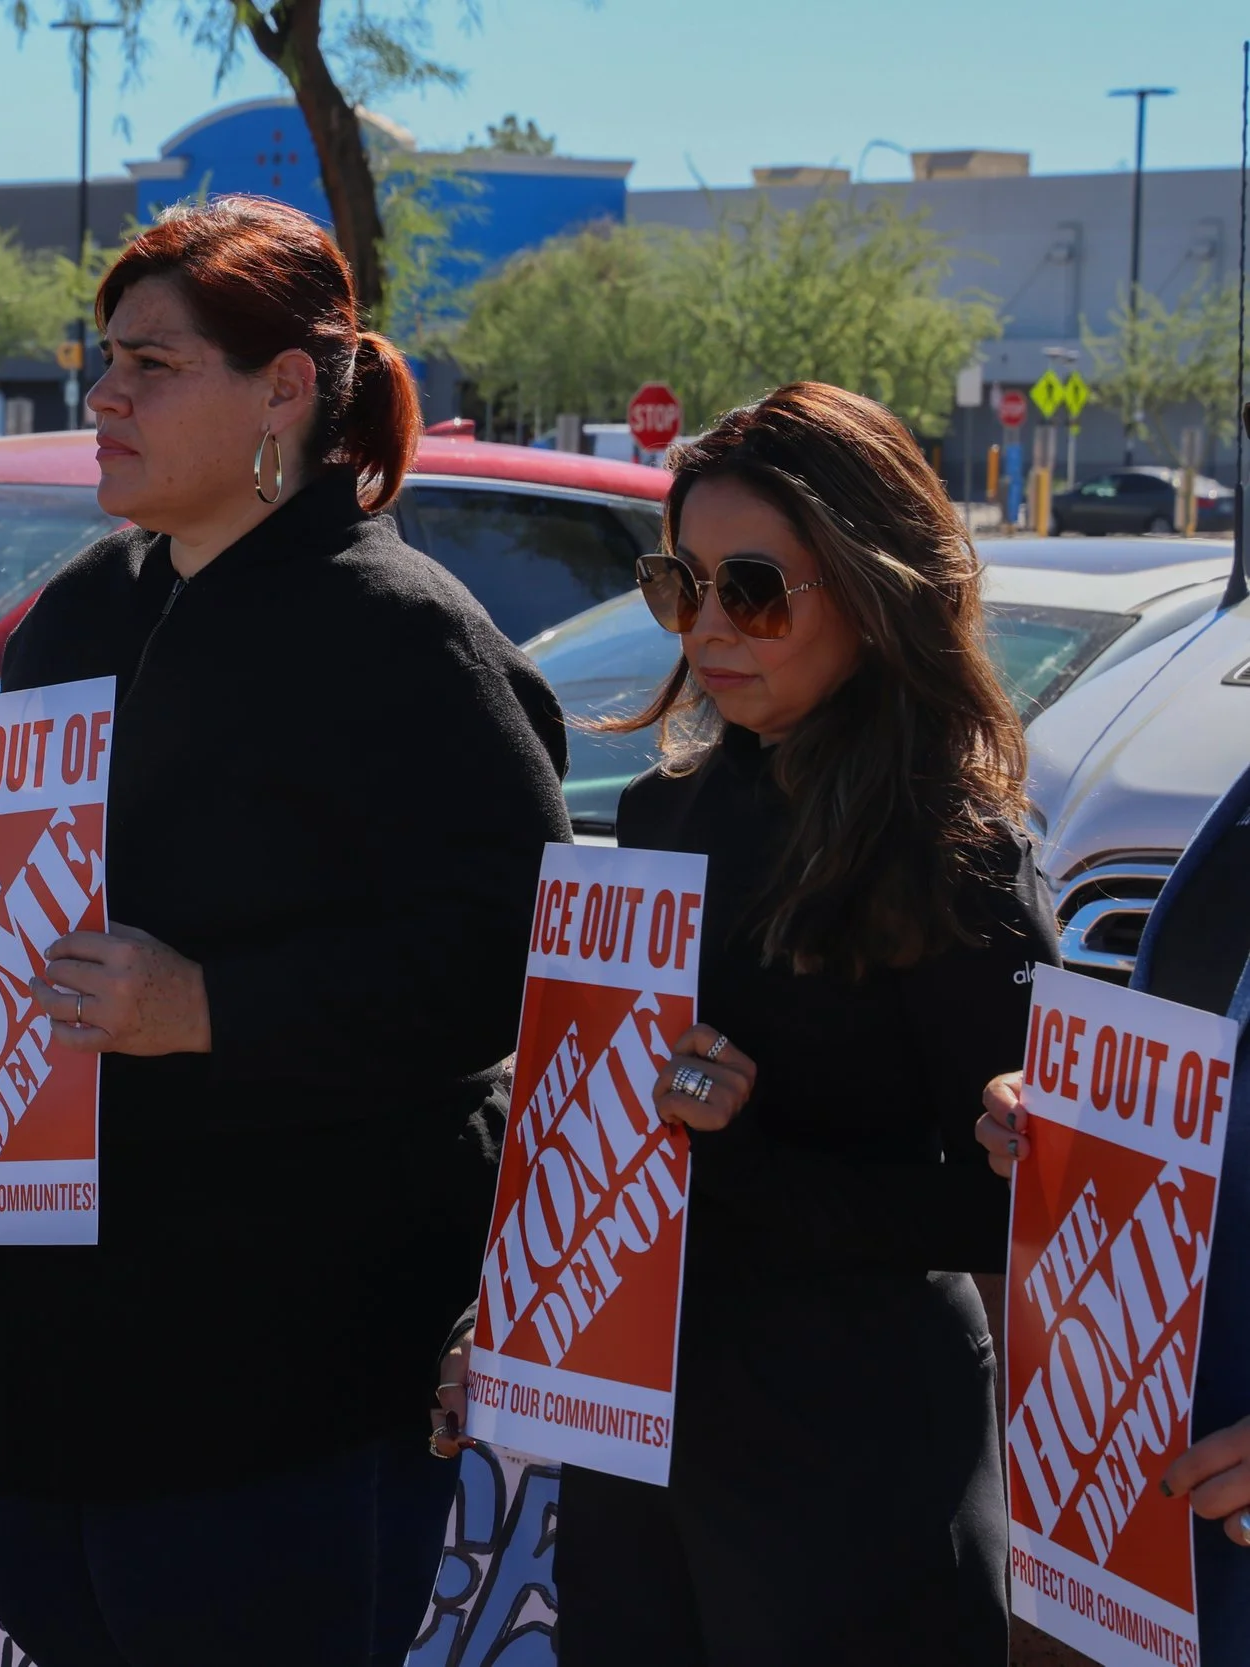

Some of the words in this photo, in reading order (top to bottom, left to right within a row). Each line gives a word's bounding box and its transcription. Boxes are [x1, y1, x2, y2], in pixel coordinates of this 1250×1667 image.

[632, 403, 679, 433] STOP
[61, 710, 111, 785] OF
[530, 879, 580, 956] ICE
[579, 882, 644, 964] OUT
[647, 889, 701, 970] OF
[516, 1020, 586, 1167] THE
[1025, 1004, 1086, 1101] ICE
[1090, 1025, 1169, 1127] OUT
[1173, 1050, 1231, 1146] OF
[483, 990, 672, 1353] HOME
[530, 1137, 685, 1367] DEPOT
[1024, 1177, 1109, 1333] THE
[510, 1383, 540, 1419] OUR
[543, 1391, 670, 1449] COMMUNITIES!
[1007, 1162, 1209, 1537] HOME
[1075, 1329, 1190, 1567] DEPOT
[1012, 1546, 1065, 1603] PROTECT
[1068, 1577, 1095, 1621] OUR
